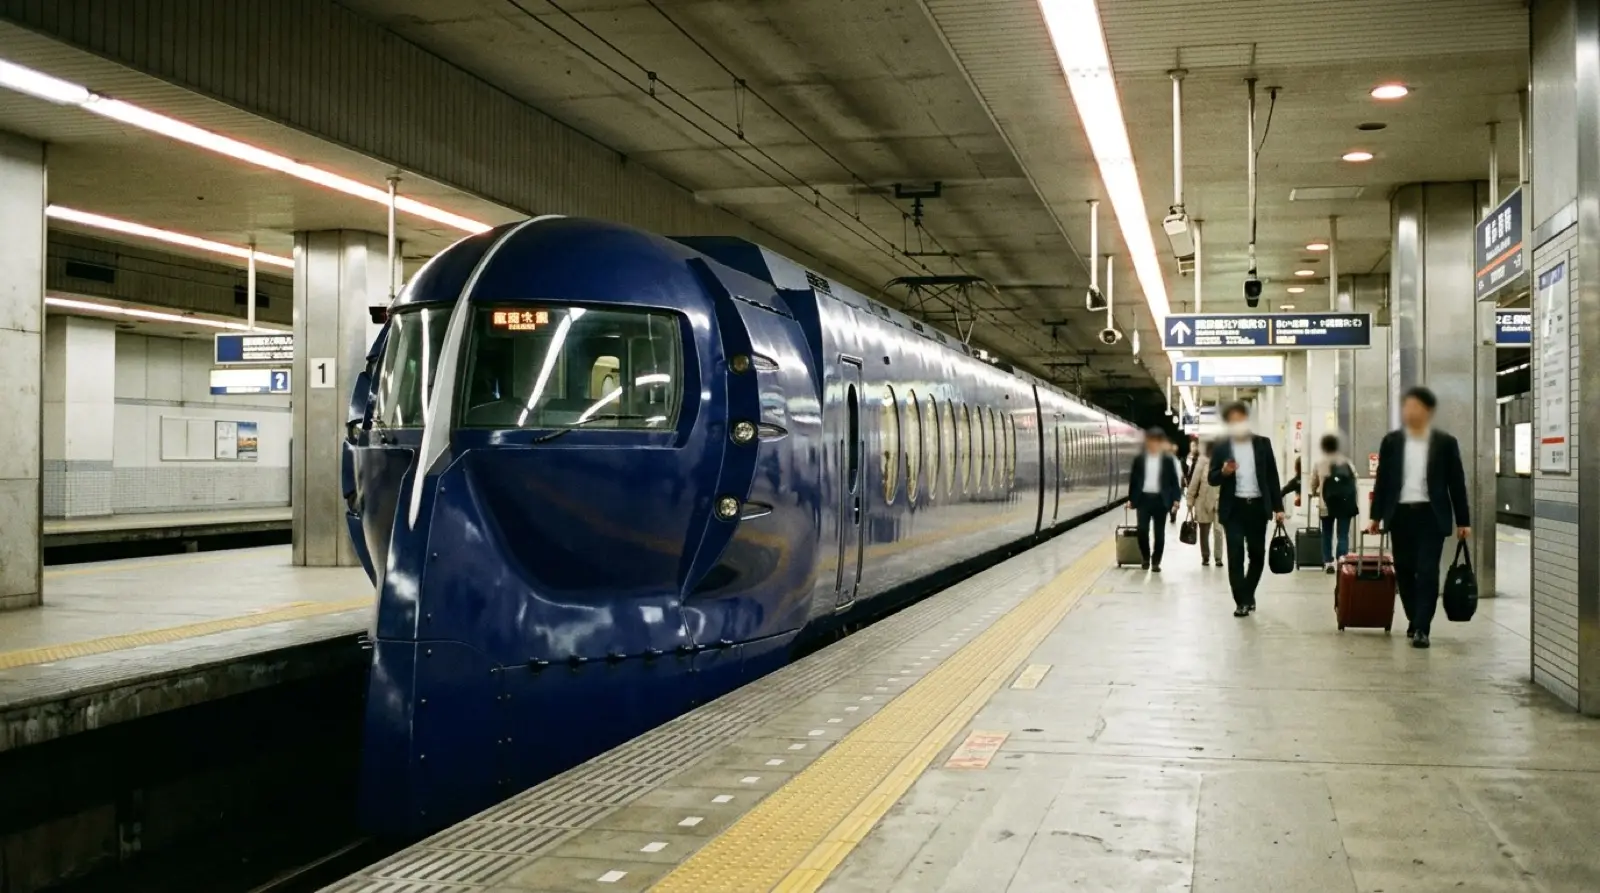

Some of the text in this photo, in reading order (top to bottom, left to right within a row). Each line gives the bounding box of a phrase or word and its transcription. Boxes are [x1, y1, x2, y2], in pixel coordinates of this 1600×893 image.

[318, 363, 325, 384] 1
[1180, 363, 1191, 380] 1
[276, 373, 284, 389] 2
